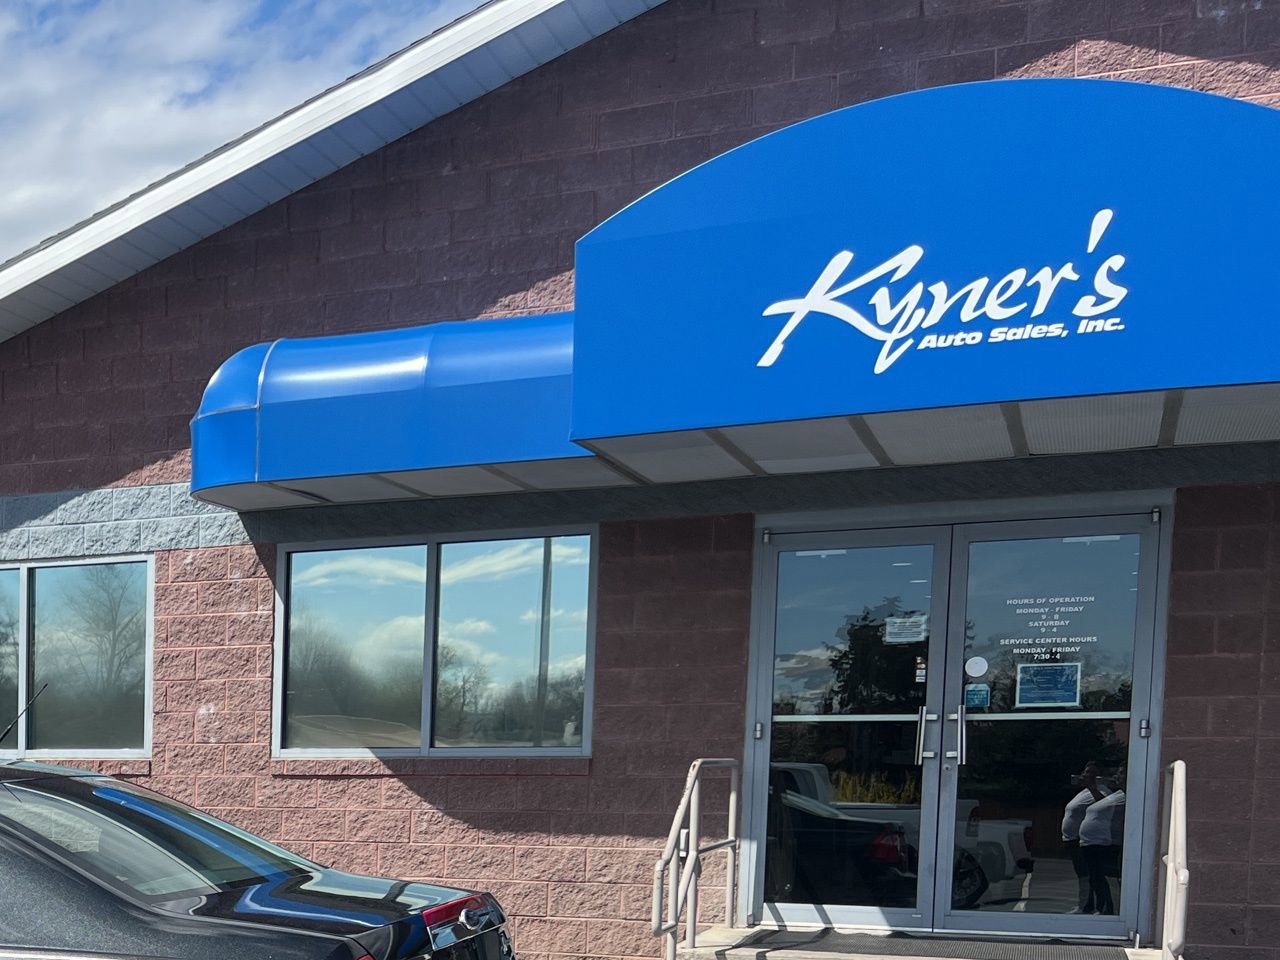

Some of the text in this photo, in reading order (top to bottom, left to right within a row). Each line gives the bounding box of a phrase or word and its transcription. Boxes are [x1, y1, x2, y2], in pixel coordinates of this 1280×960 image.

[756, 208, 1129, 375] Kyner's
[917, 317, 1125, 350] Auto Sales, Inc.
[1006, 598, 1035, 606] HOURS
[1048, 596, 1095, 604] OPERATION
